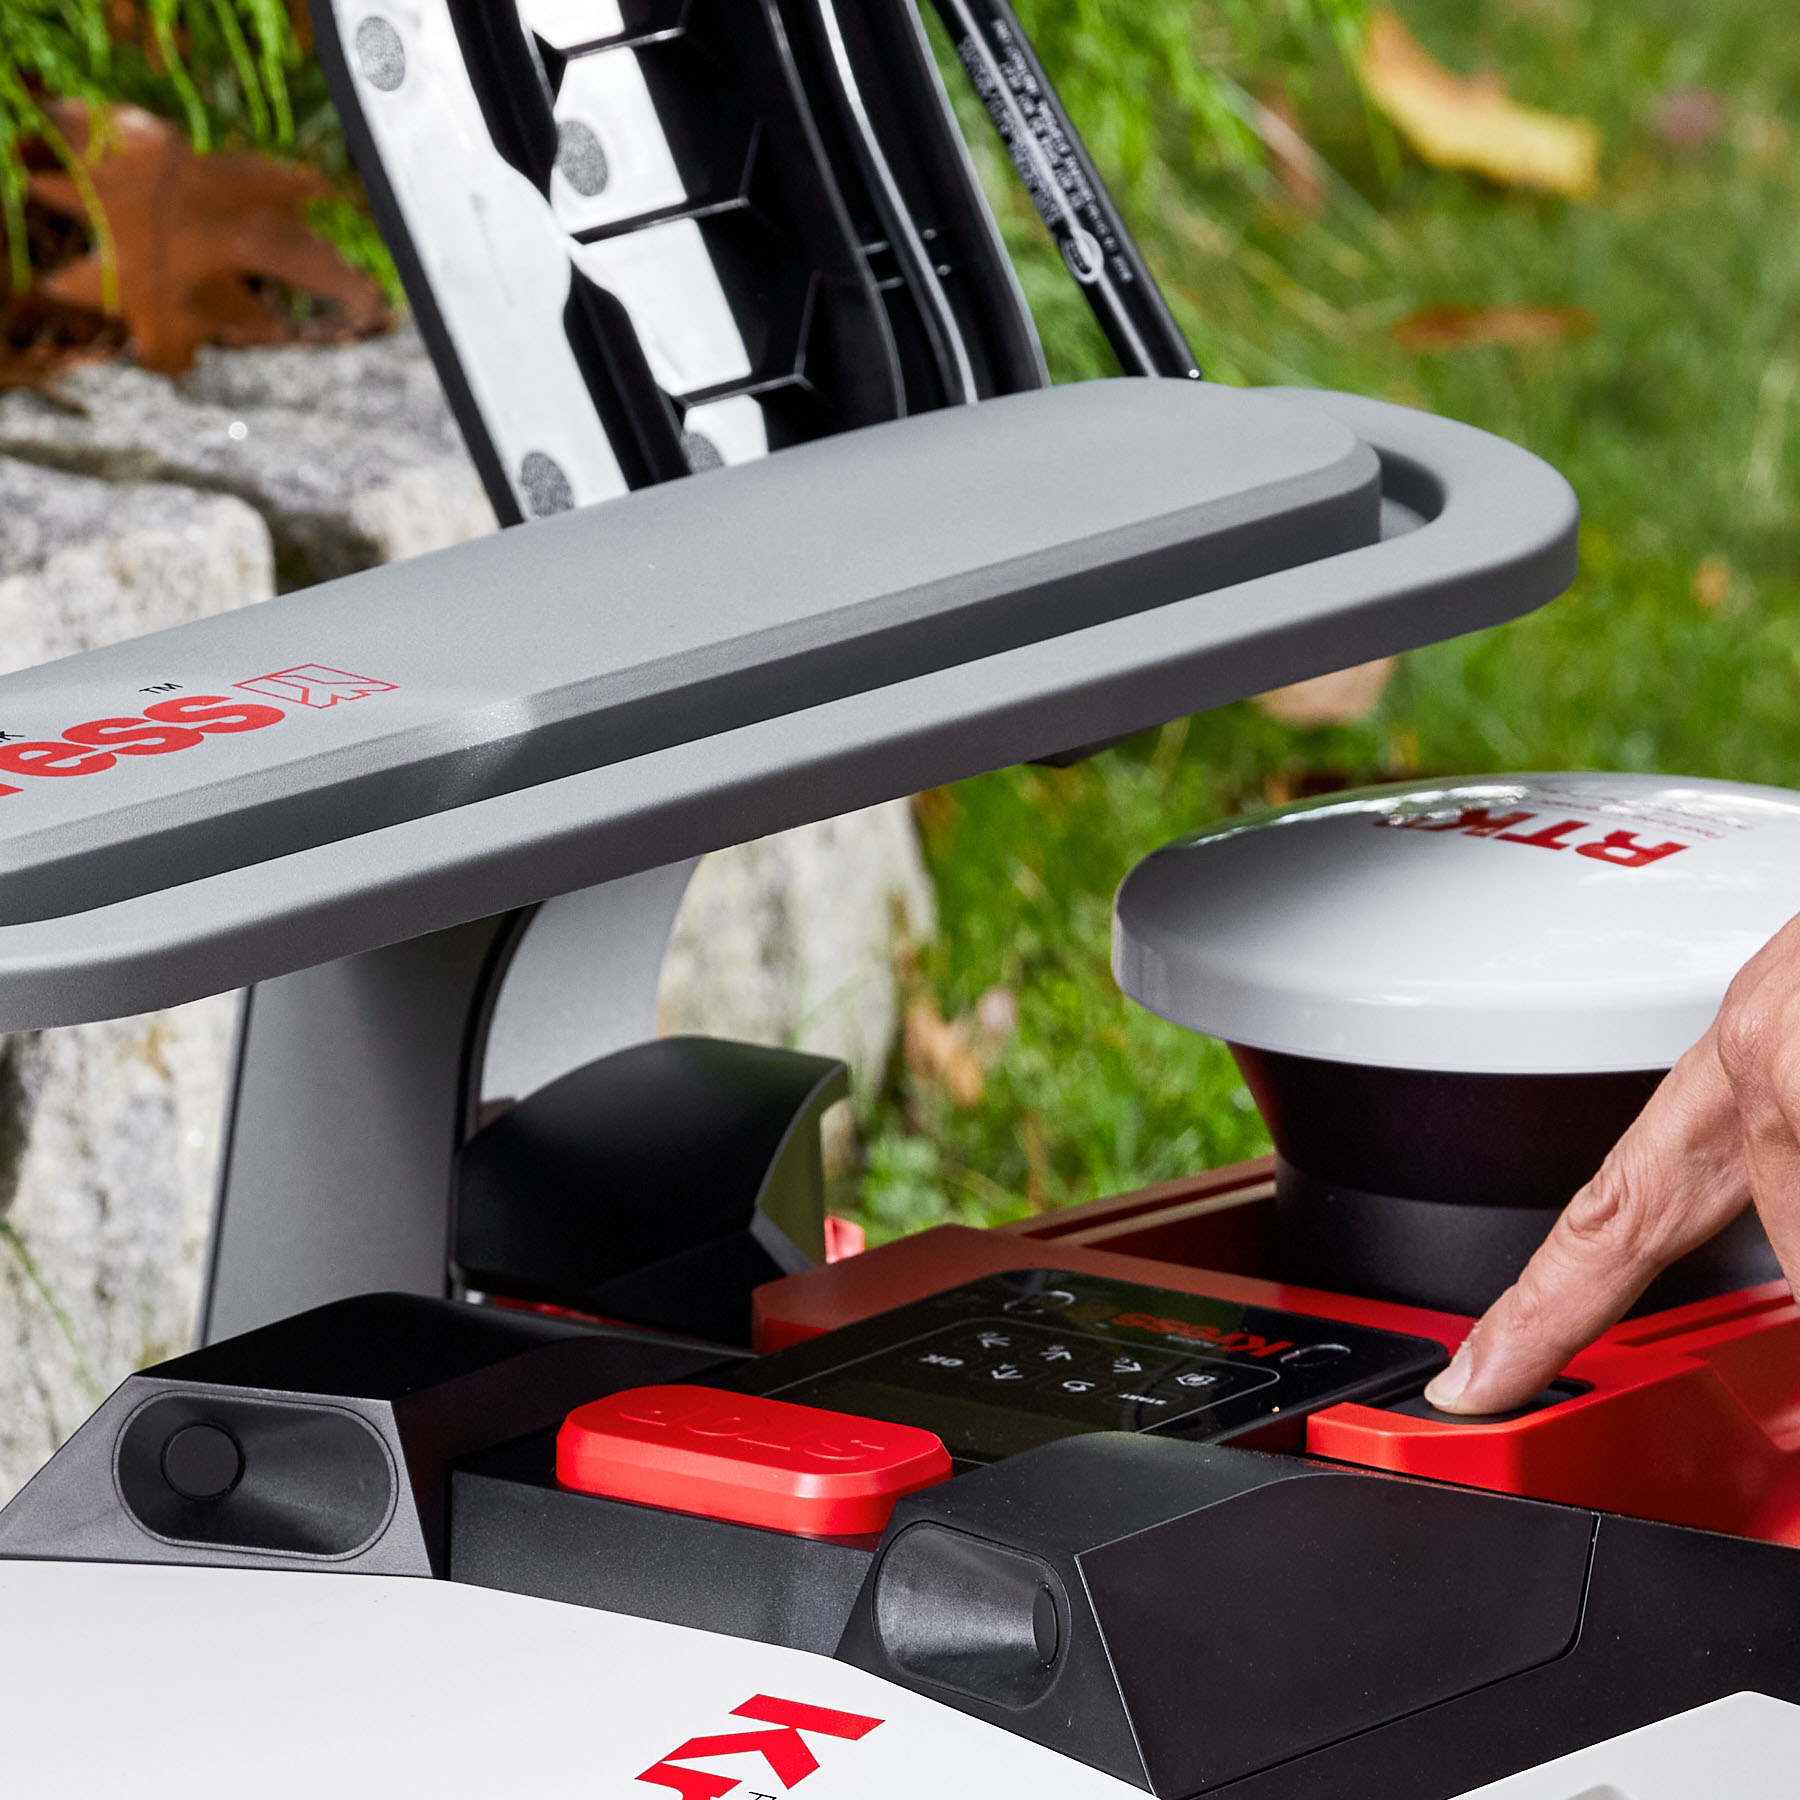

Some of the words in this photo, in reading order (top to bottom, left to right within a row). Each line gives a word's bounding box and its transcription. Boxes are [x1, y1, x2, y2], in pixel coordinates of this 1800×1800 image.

[1112, 1312, 1294, 1358] Kress
[919, 1354, 965, 1367] OK
[1118, 1393, 1167, 1406] START
[618, 1407, 890, 1461] STOP
